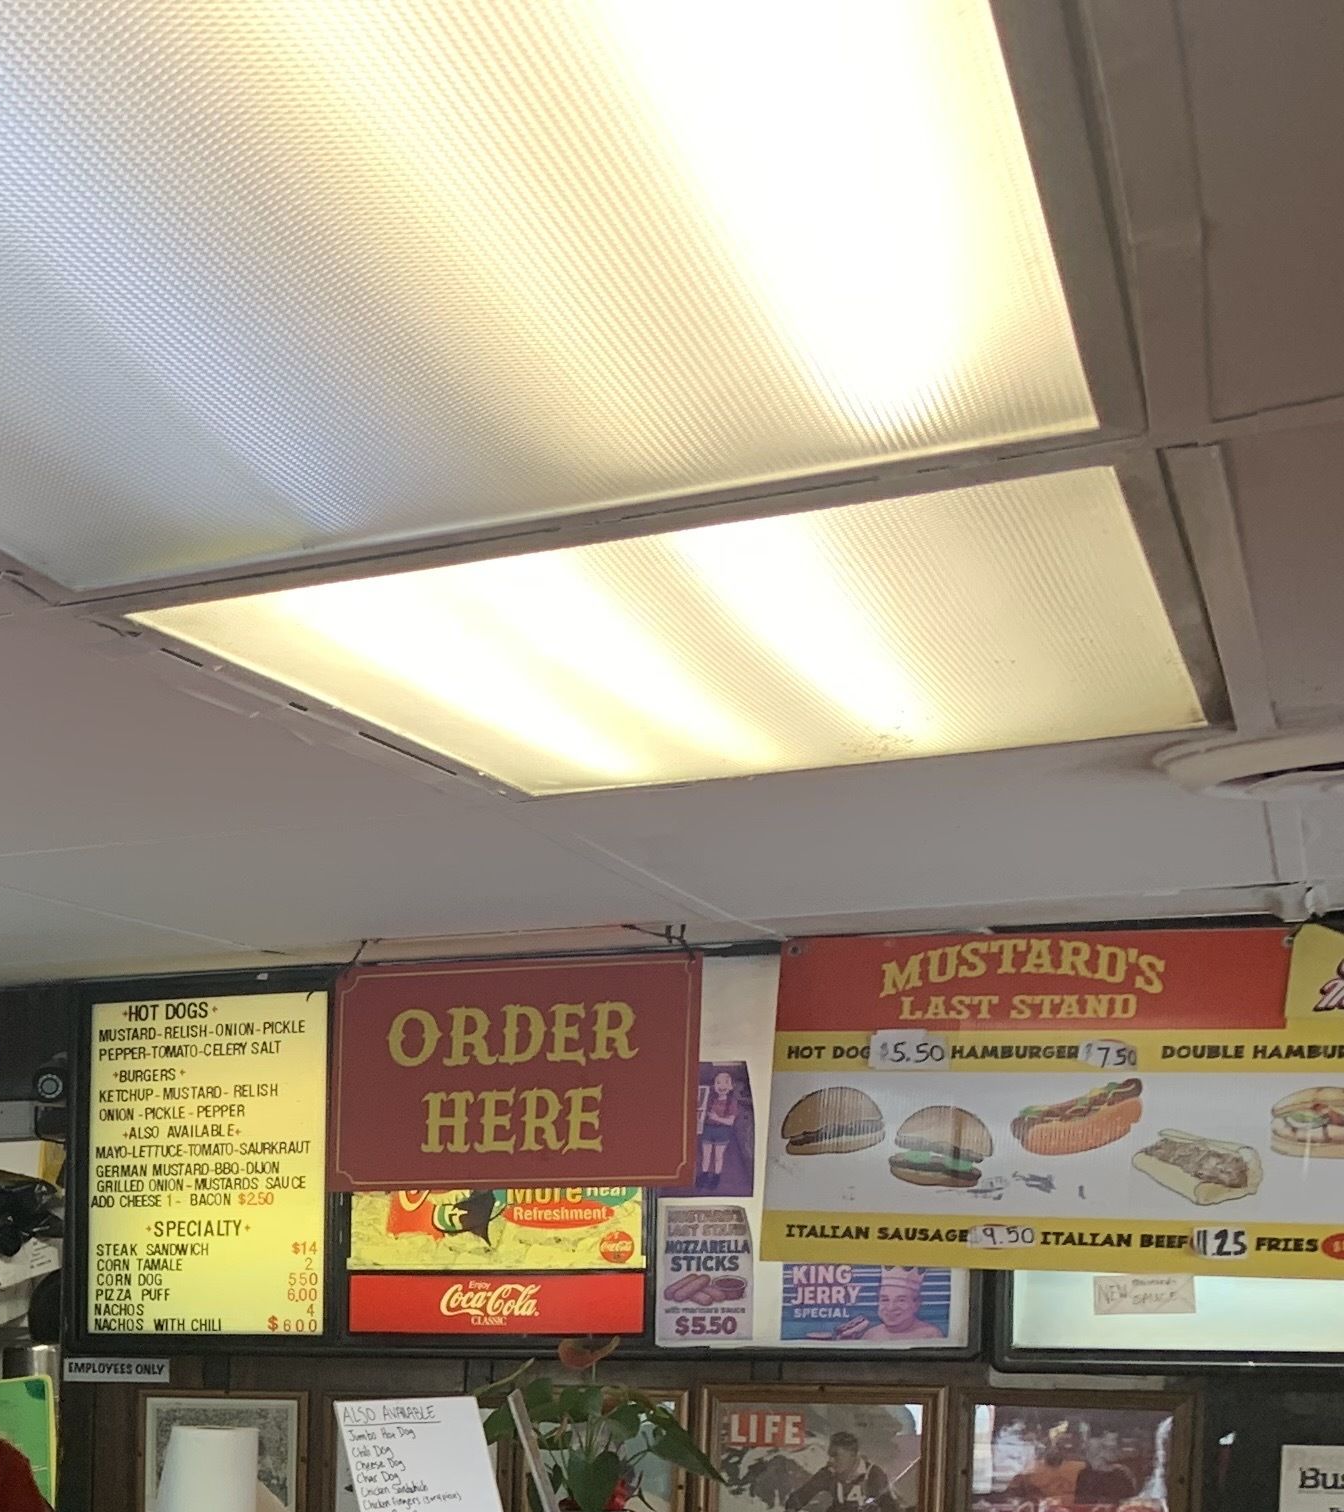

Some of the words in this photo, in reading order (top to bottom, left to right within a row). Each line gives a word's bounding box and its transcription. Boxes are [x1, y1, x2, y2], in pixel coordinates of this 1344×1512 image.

[880, 937, 1166, 998] MUSTARD'S
[128, 1005, 159, 1022] HOT
[165, 1002, 209, 1020] DOGS
[898, 995, 999, 1020] LAST
[1011, 993, 1138, 1019] STAND
[387, 1000, 640, 1068] ORDER
[251, 1040, 282, 1055] SALT
[787, 1045, 826, 1060] HOT
[831, 1045, 871, 1059] DOG
[951, 1044, 1079, 1060] HAMBURGER
[1161, 1045, 1245, 1059] DOUBLE
[119, 1069, 176, 1083] BURGERS
[233, 1083, 279, 1097] RELISH
[197, 1104, 245, 1118] PEPPER
[420, 1084, 605, 1155] HERE
[128, 1126, 159, 1140] ALSO
[167, 1124, 235, 1139] AVAILABLE
[96, 1164, 147, 1178] GERMAN
[96, 1179, 144, 1193] GRILLED
[265, 1175, 306, 1189] SAUCE
[91, 1195, 115, 1208] ADD
[119, 1195, 162, 1208] CHEESE
[190, 1193, 232, 1206] BACON
[153, 1219, 242, 1238] SPECIALTY
[785, 1224, 870, 1240] ITALIAN
[877, 1226, 969, 1243] SAUSAGE
[664, 1239, 750, 1255] MOZZARELLA
[1040, 1231, 1133, 1248] ITALIAN
[1139, 1234, 1189, 1249] BEEF
[1255, 1237, 1319, 1252] FRIES
[96, 1243, 138, 1256] STEAK
[146, 1242, 209, 1256] SANDWICH
[292, 1241, 317, 1255] $14
[96, 1258, 132, 1272] CORN
[136, 1258, 183, 1271] TAMALE
[670, 1255, 740, 1272] STICKS
[96, 1273, 132, 1287] CORN
[137, 1273, 163, 1286] DOG
[792, 1265, 853, 1285] KING
[468, 1281, 491, 1291] Enjoy
[95, 1288, 132, 1302] PIZZA
[141, 1288, 171, 1301] PUFF
[440, 1283, 542, 1317] Coca-Cola
[792, 1286, 861, 1305] JERRY
[94, 1303, 144, 1316] NACHOS
[793, 1308, 850, 1319] SPECIAL
[94, 1318, 144, 1332] NACHOS
[154, 1319, 185, 1332] WITH
[191, 1318, 222, 1332] CHILI
[471, 1315, 507, 1326] CLASSIC
[675, 1315, 738, 1336] $5.50
[67, 1361, 130, 1376] EMPLOYEES
[133, 1360, 167, 1375] ONLY
[343, 1405, 377, 1424] ALSO
[396, 1426, 417, 1440] Dog
[729, 1413, 803, 1445] LIFE
[372, 1445, 394, 1459] Dog
[355, 1461, 386, 1472] Cheese
[386, 1457, 407, 1472] Dog
[380, 1470, 402, 1486] Dog
